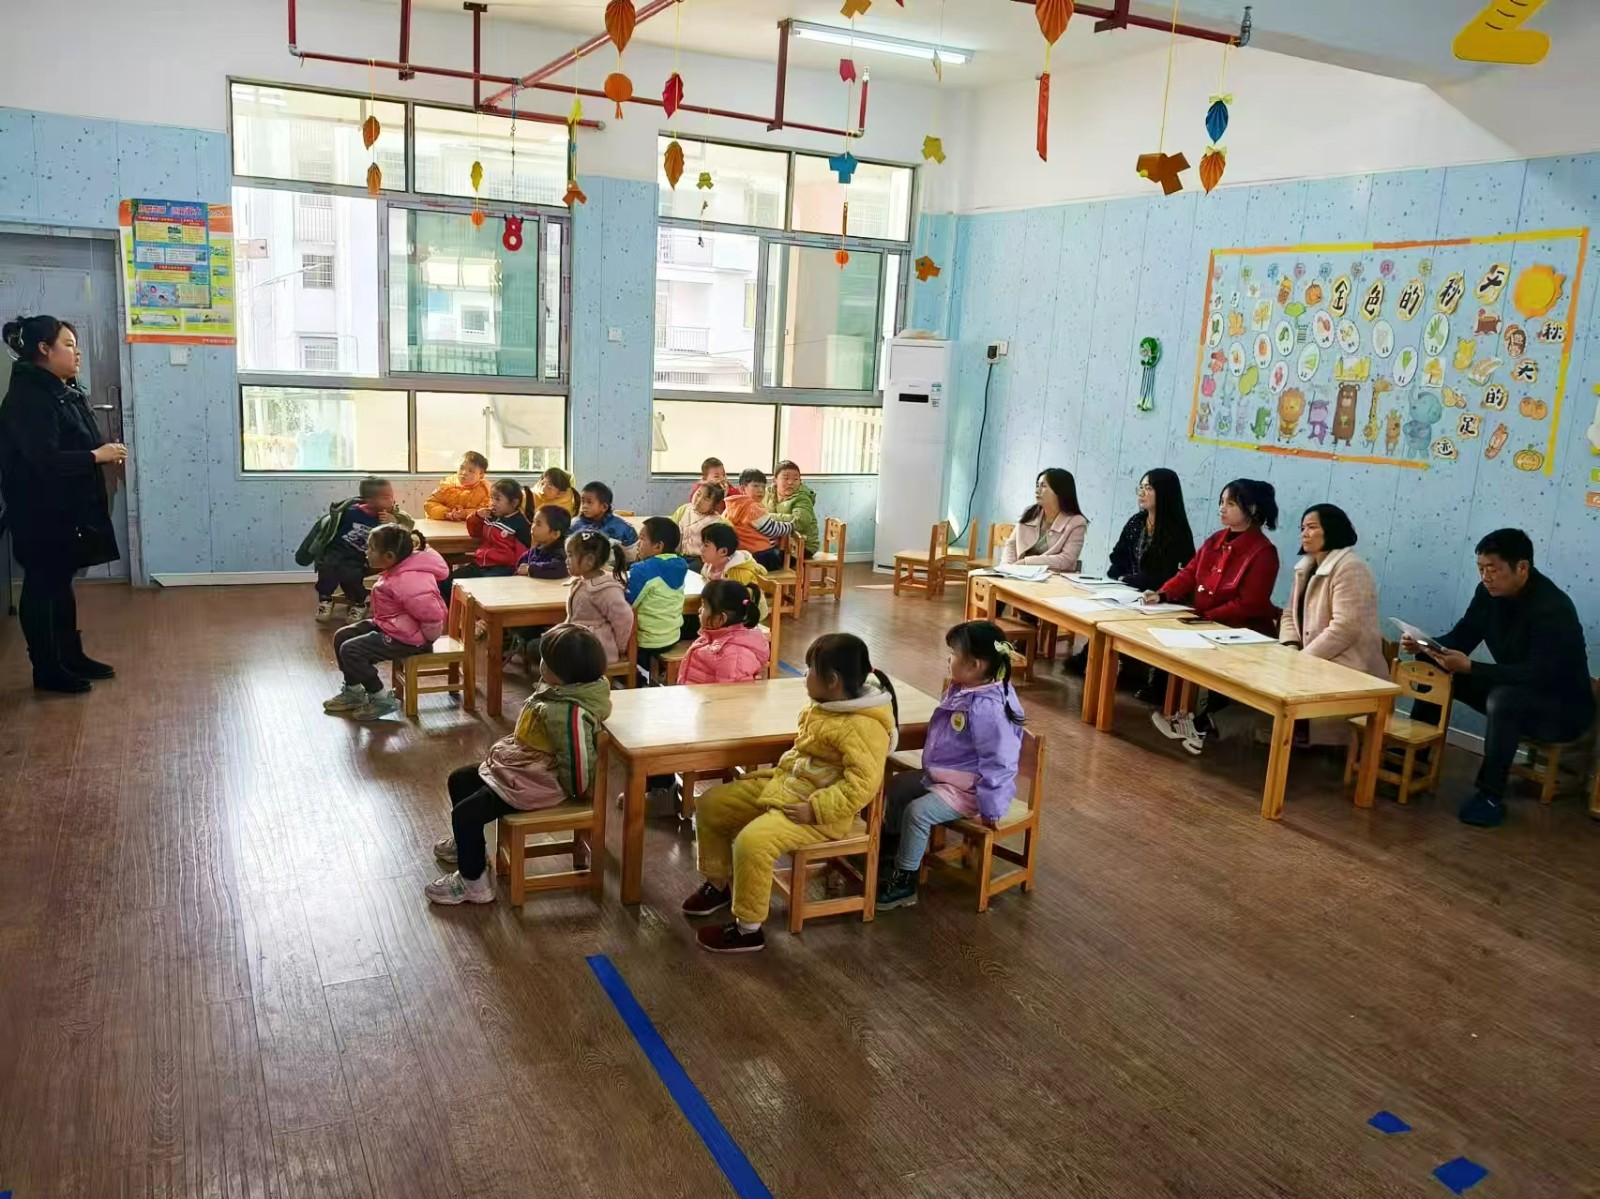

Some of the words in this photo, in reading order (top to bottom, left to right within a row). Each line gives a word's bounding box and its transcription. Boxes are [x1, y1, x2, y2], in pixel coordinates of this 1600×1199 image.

[1332, 270, 1505, 316] 金色的秋天
